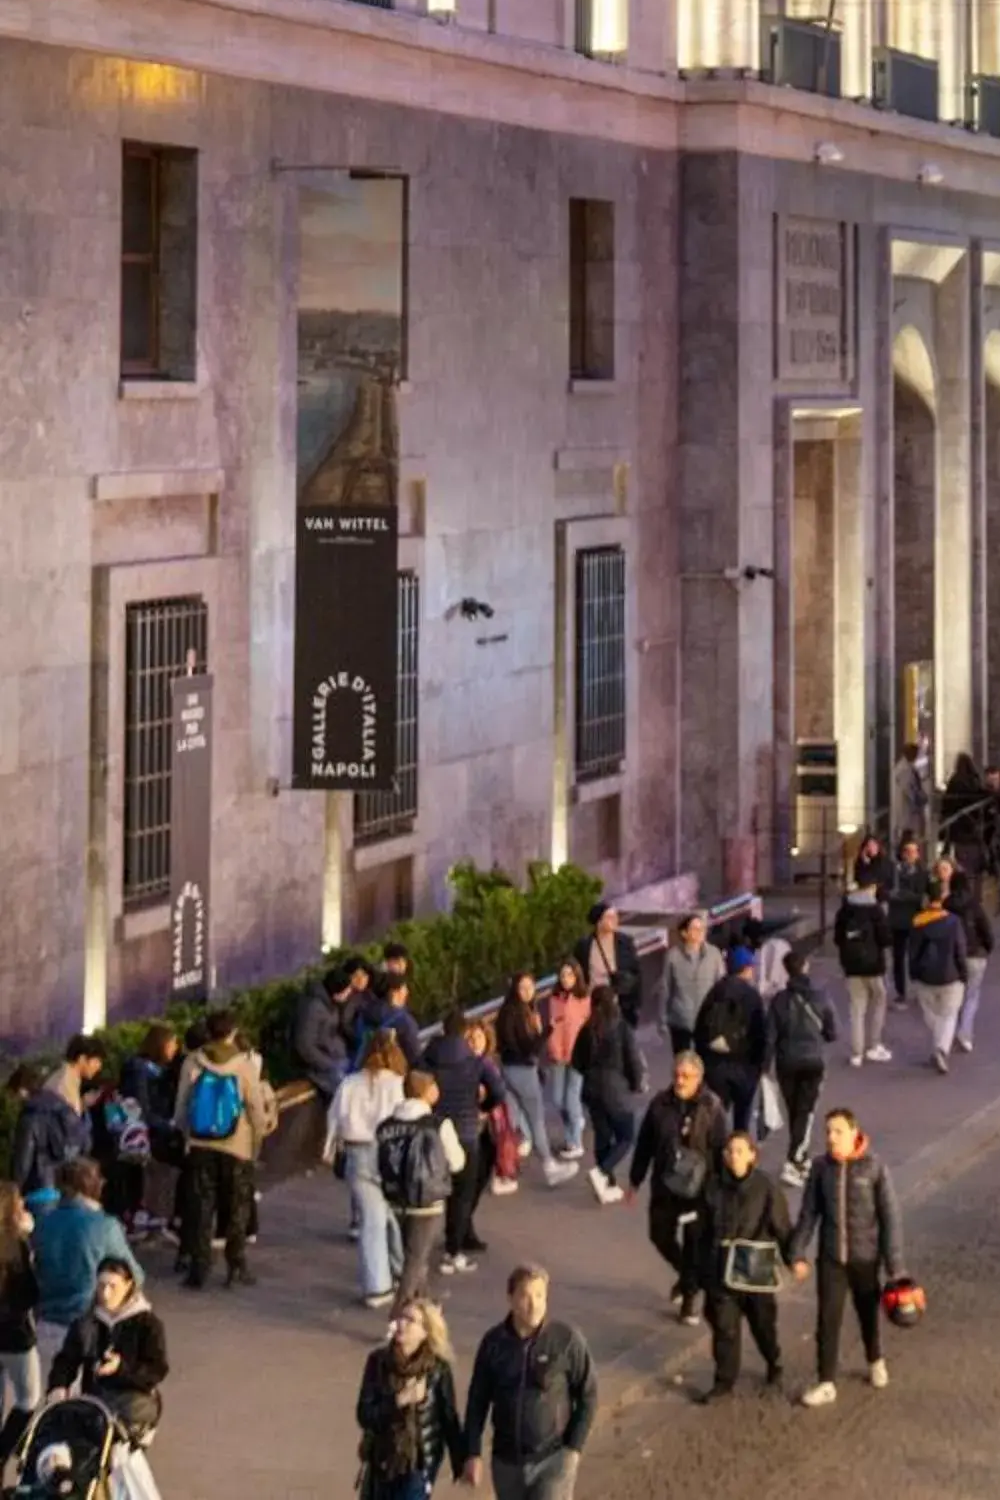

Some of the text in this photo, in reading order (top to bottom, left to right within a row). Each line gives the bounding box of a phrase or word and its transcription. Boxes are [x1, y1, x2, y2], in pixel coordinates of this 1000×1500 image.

[304, 516, 390, 532] VAN WITTEL
[312, 671, 349, 760] GALLERIE
[311, 762, 377, 779] NAPOLI
